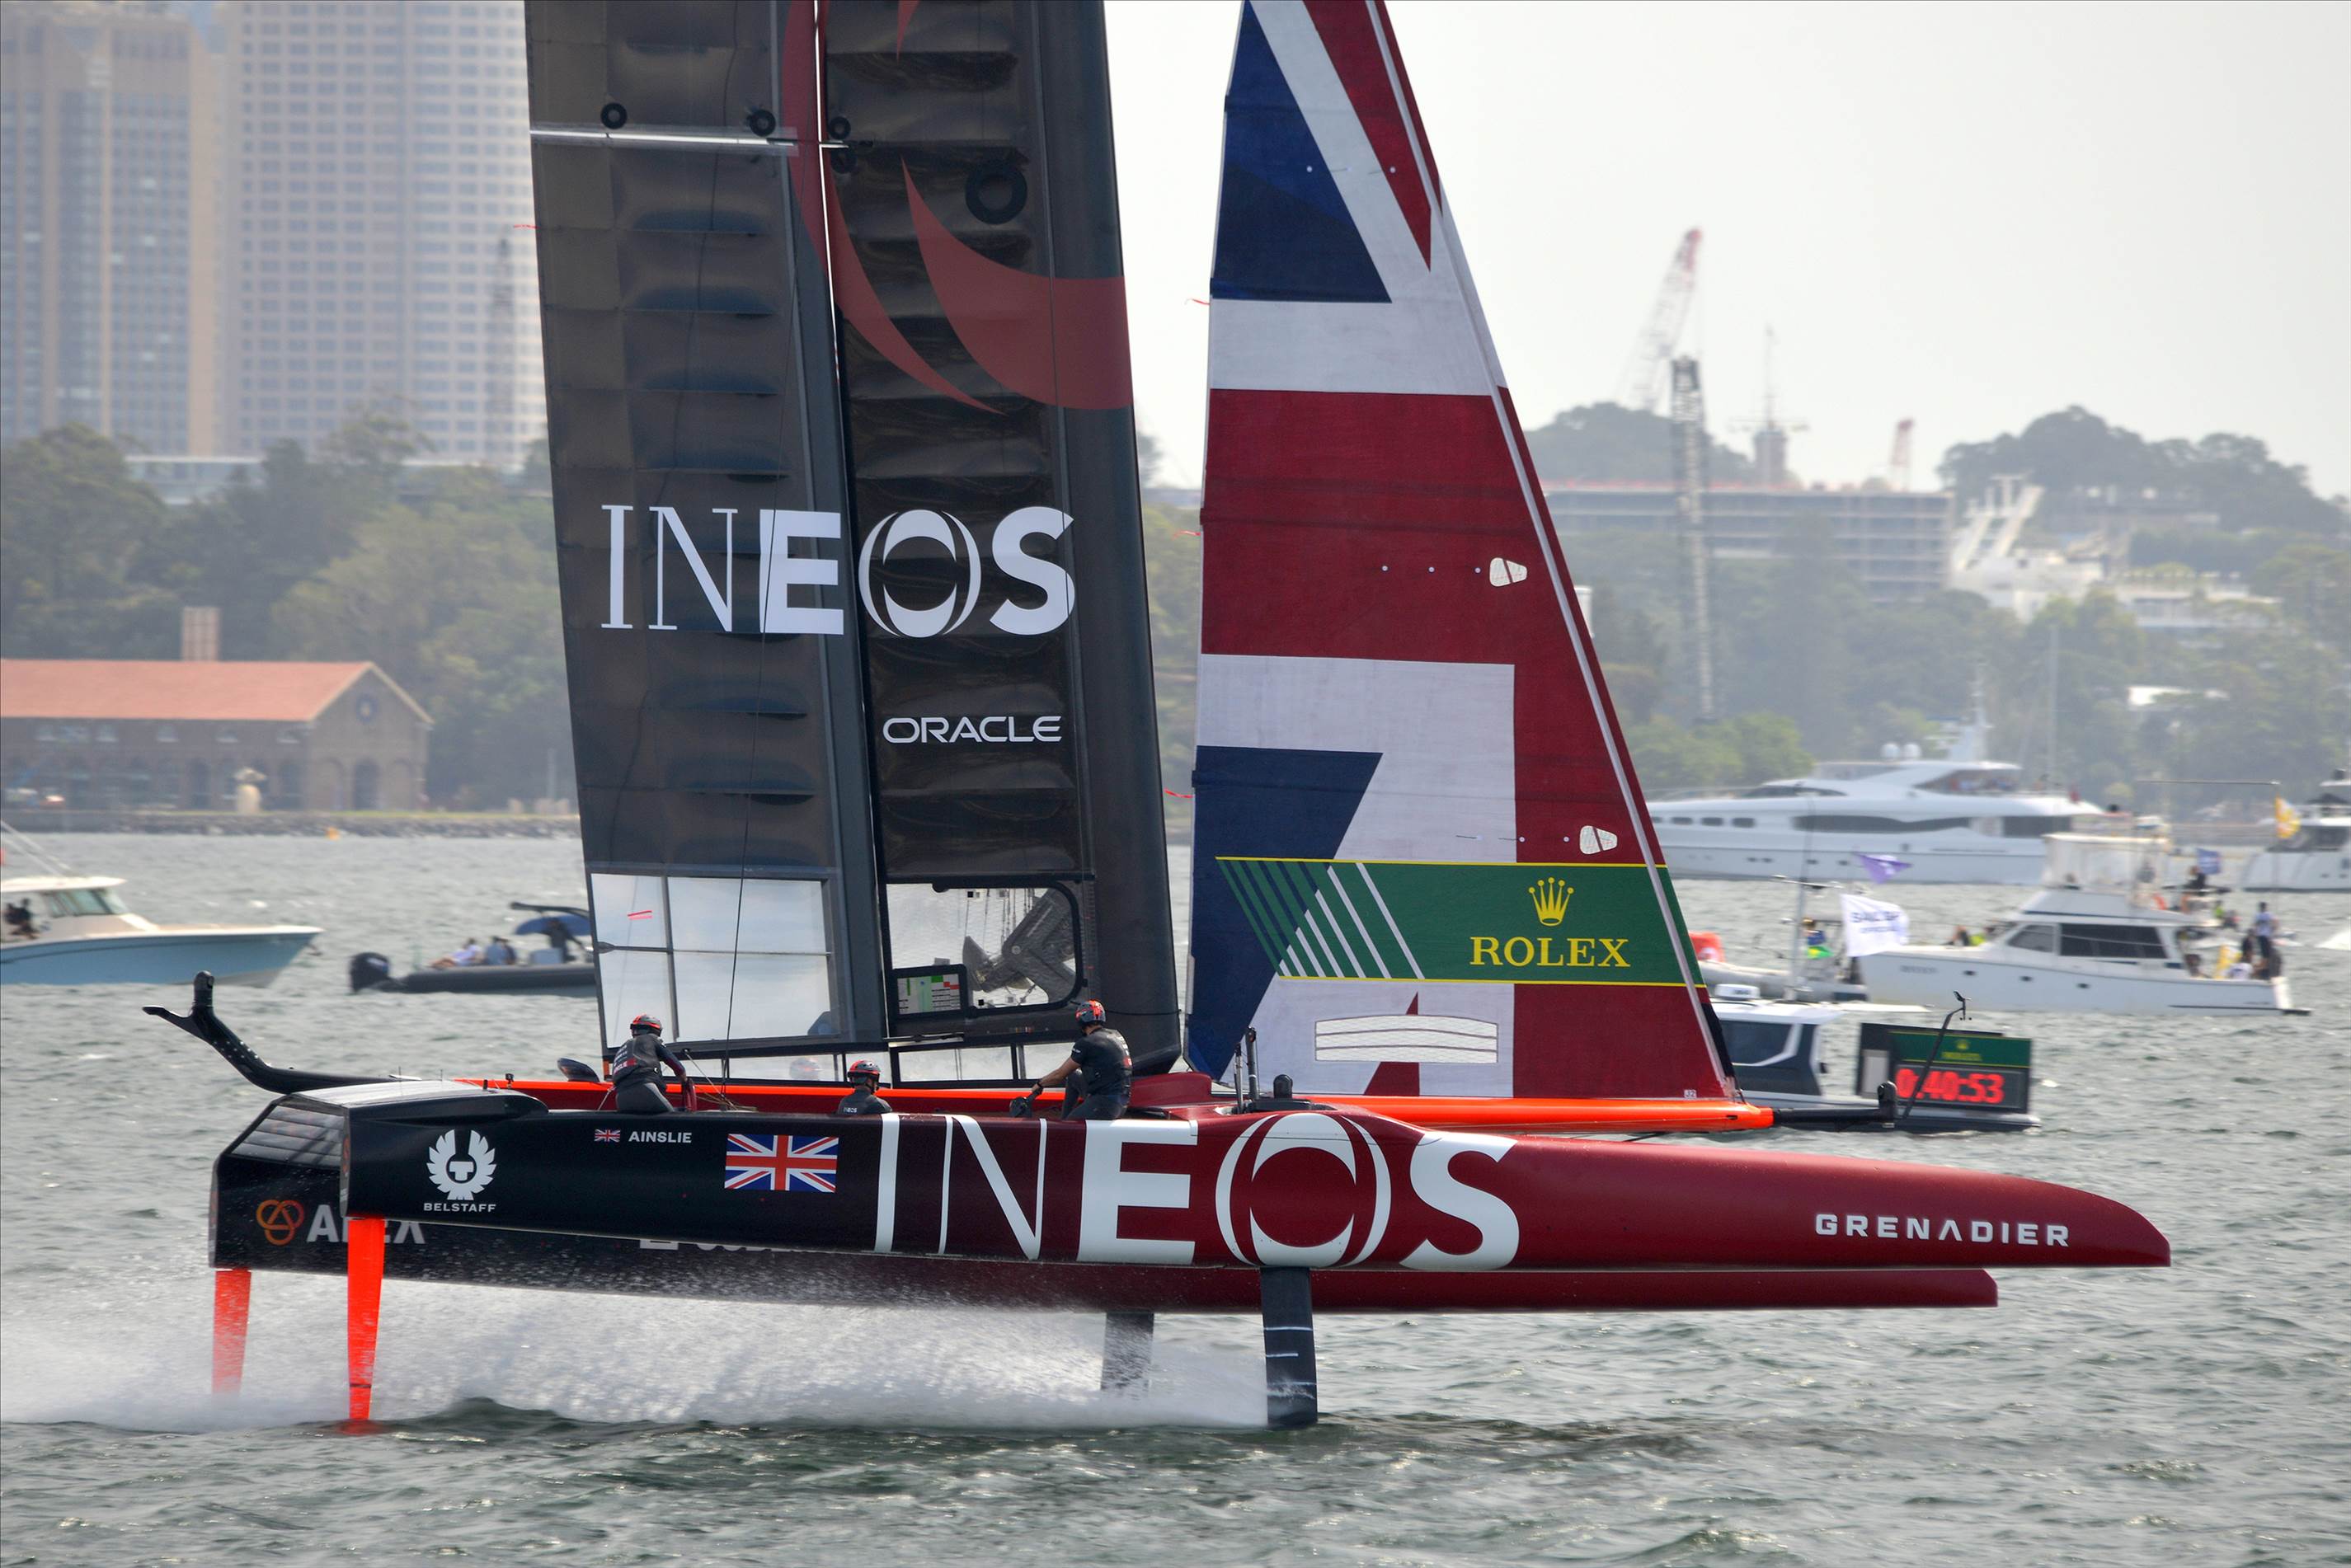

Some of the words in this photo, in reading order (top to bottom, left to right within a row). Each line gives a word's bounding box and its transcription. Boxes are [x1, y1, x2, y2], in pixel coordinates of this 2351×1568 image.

[601, 505, 1076, 638] INEOS
[882, 716, 1062, 743] ORACLE
[1469, 937, 1630, 968] ROLEX
[628, 1131, 693, 1143] AINSLIE
[873, 1111, 1520, 1271] INEOS
[306, 1204, 426, 1244] AX
[424, 1203, 496, 1213] BELSTAFF
[1815, 1213, 2071, 1246] GRENADIER
